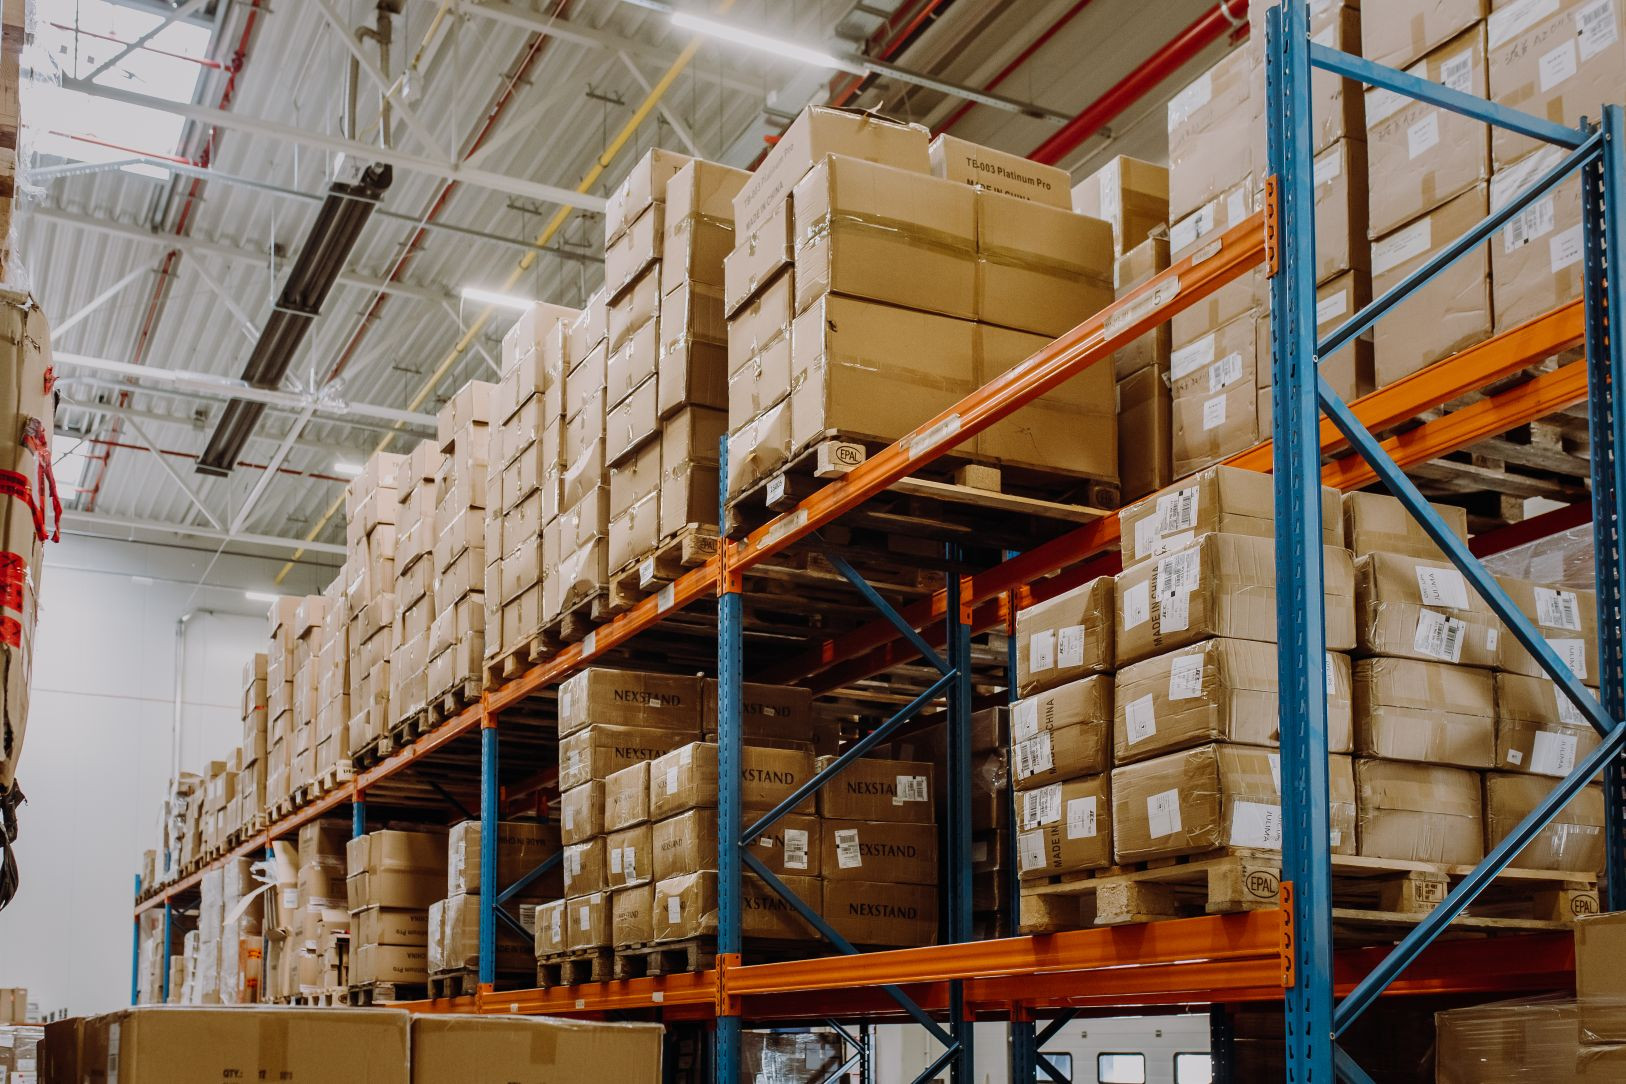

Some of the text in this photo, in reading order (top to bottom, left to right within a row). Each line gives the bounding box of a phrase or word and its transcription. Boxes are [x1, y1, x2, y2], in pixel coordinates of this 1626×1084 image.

[997, 166, 1035, 186] Platinum
[1036, 177, 1052, 191] Pro
[767, 180, 784, 206] CHINA
[840, 449, 859, 463] EPAL
[1152, 614, 1162, 647] MADE
[614, 689, 681, 707] NEXSTAND
[858, 842, 916, 858] EXSTAND
[1050, 825, 1063, 868] MADE IN
[1250, 876, 1276, 894] EPAL
[849, 903, 917, 920] NEXSTAND
[1574, 899, 1594, 914] EPAL
